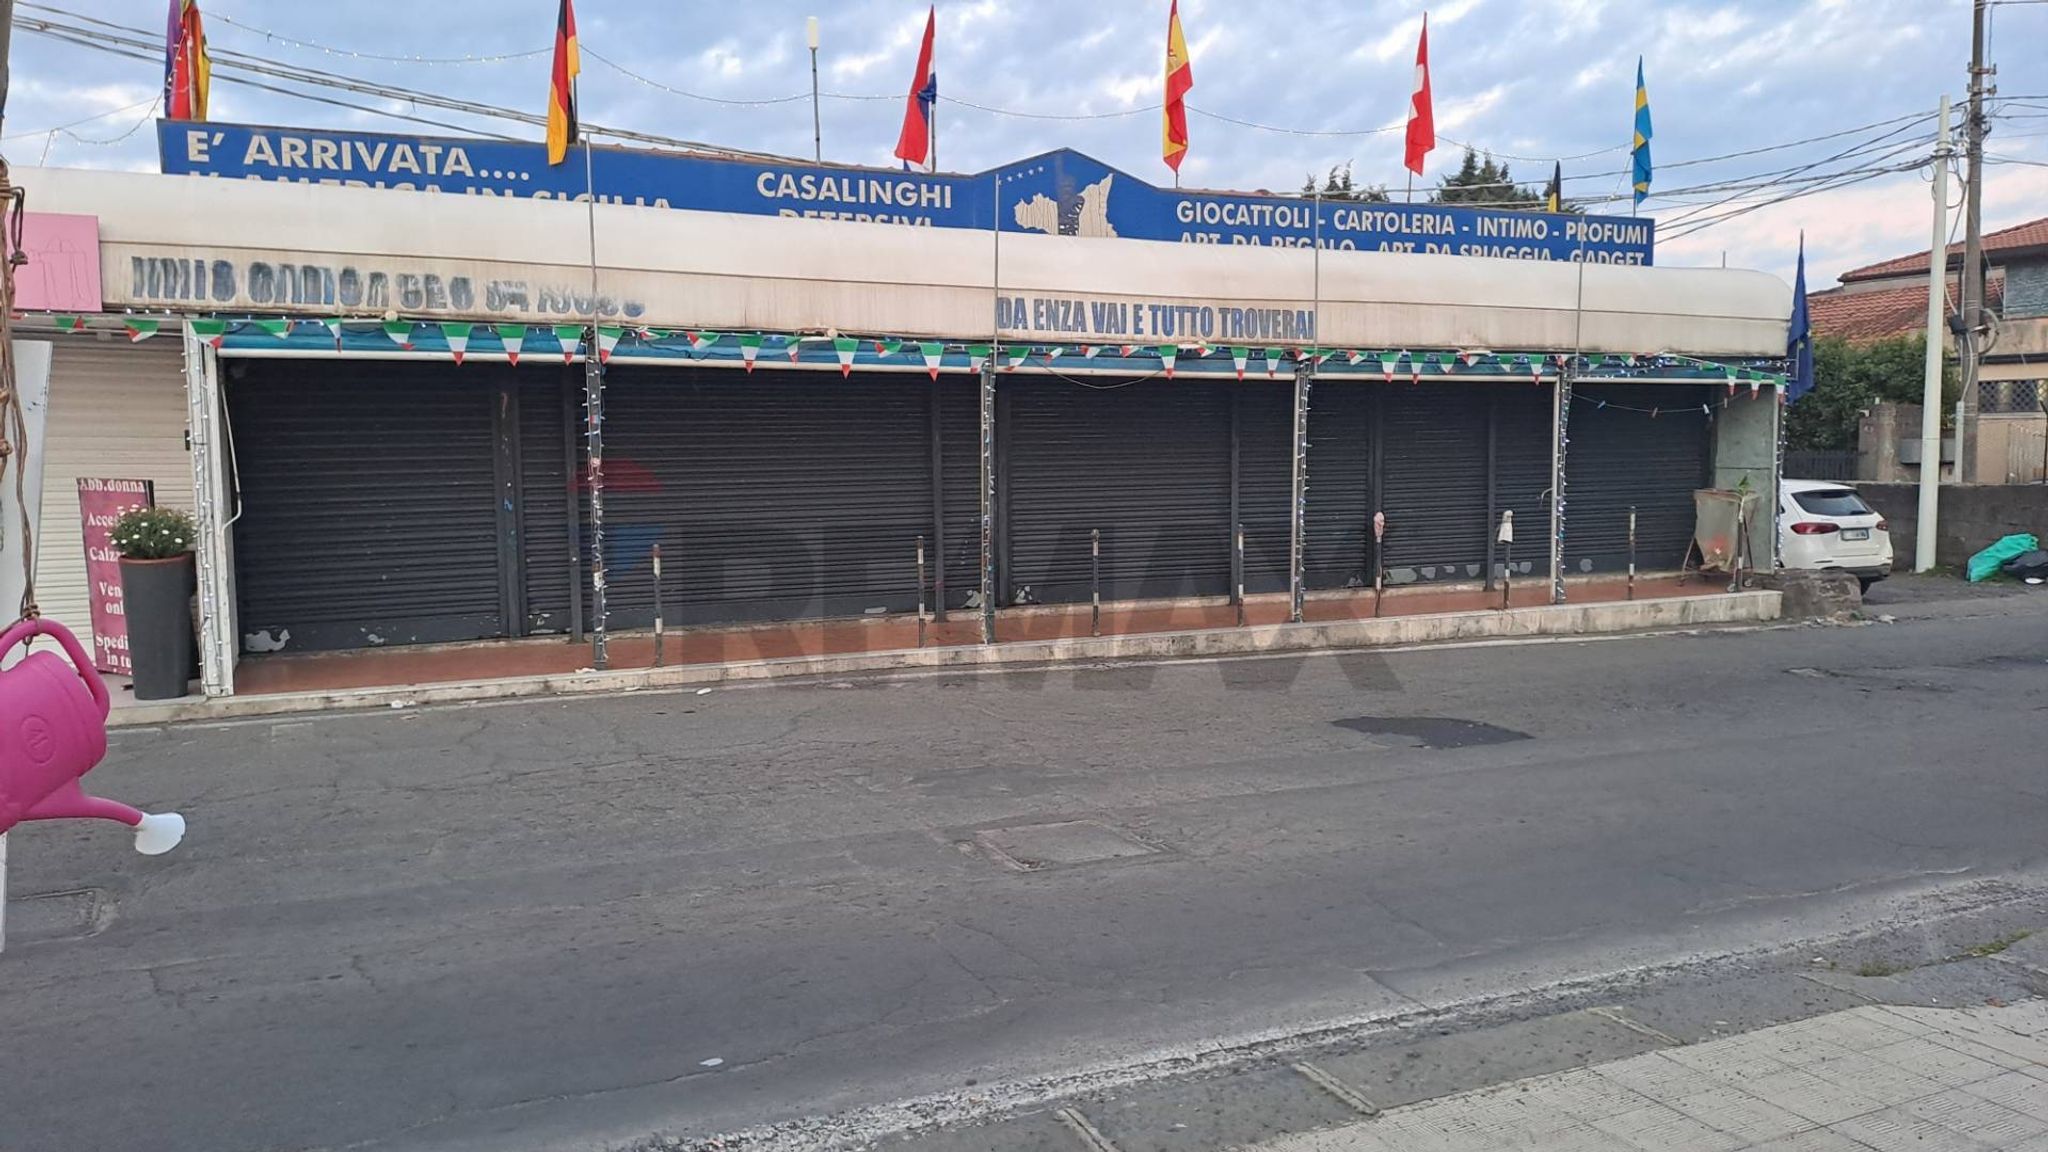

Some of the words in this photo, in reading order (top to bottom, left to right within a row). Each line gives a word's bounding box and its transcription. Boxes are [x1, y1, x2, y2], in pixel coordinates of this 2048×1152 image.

[186, 130, 224, 163] E'
[756, 171, 952, 209] CASALINGHI
[1176, 200, 1310, 229] GIOCATTOLI
[1333, 208, 1456, 236] CARTOLERIA
[1476, 216, 1548, 240] INTIMO
[1565, 220, 1648, 245] PROFUMI
[1569, 248, 1646, 266] GADGET
[997, 296, 1028, 331] DA
[1033, 298, 1088, 333] ENZA
[1091, 301, 1127, 335] VAI
[1133, 303, 1145, 335] E
[1148, 303, 1215, 338] TUTTO
[1218, 307, 1315, 340] TROVERAI
